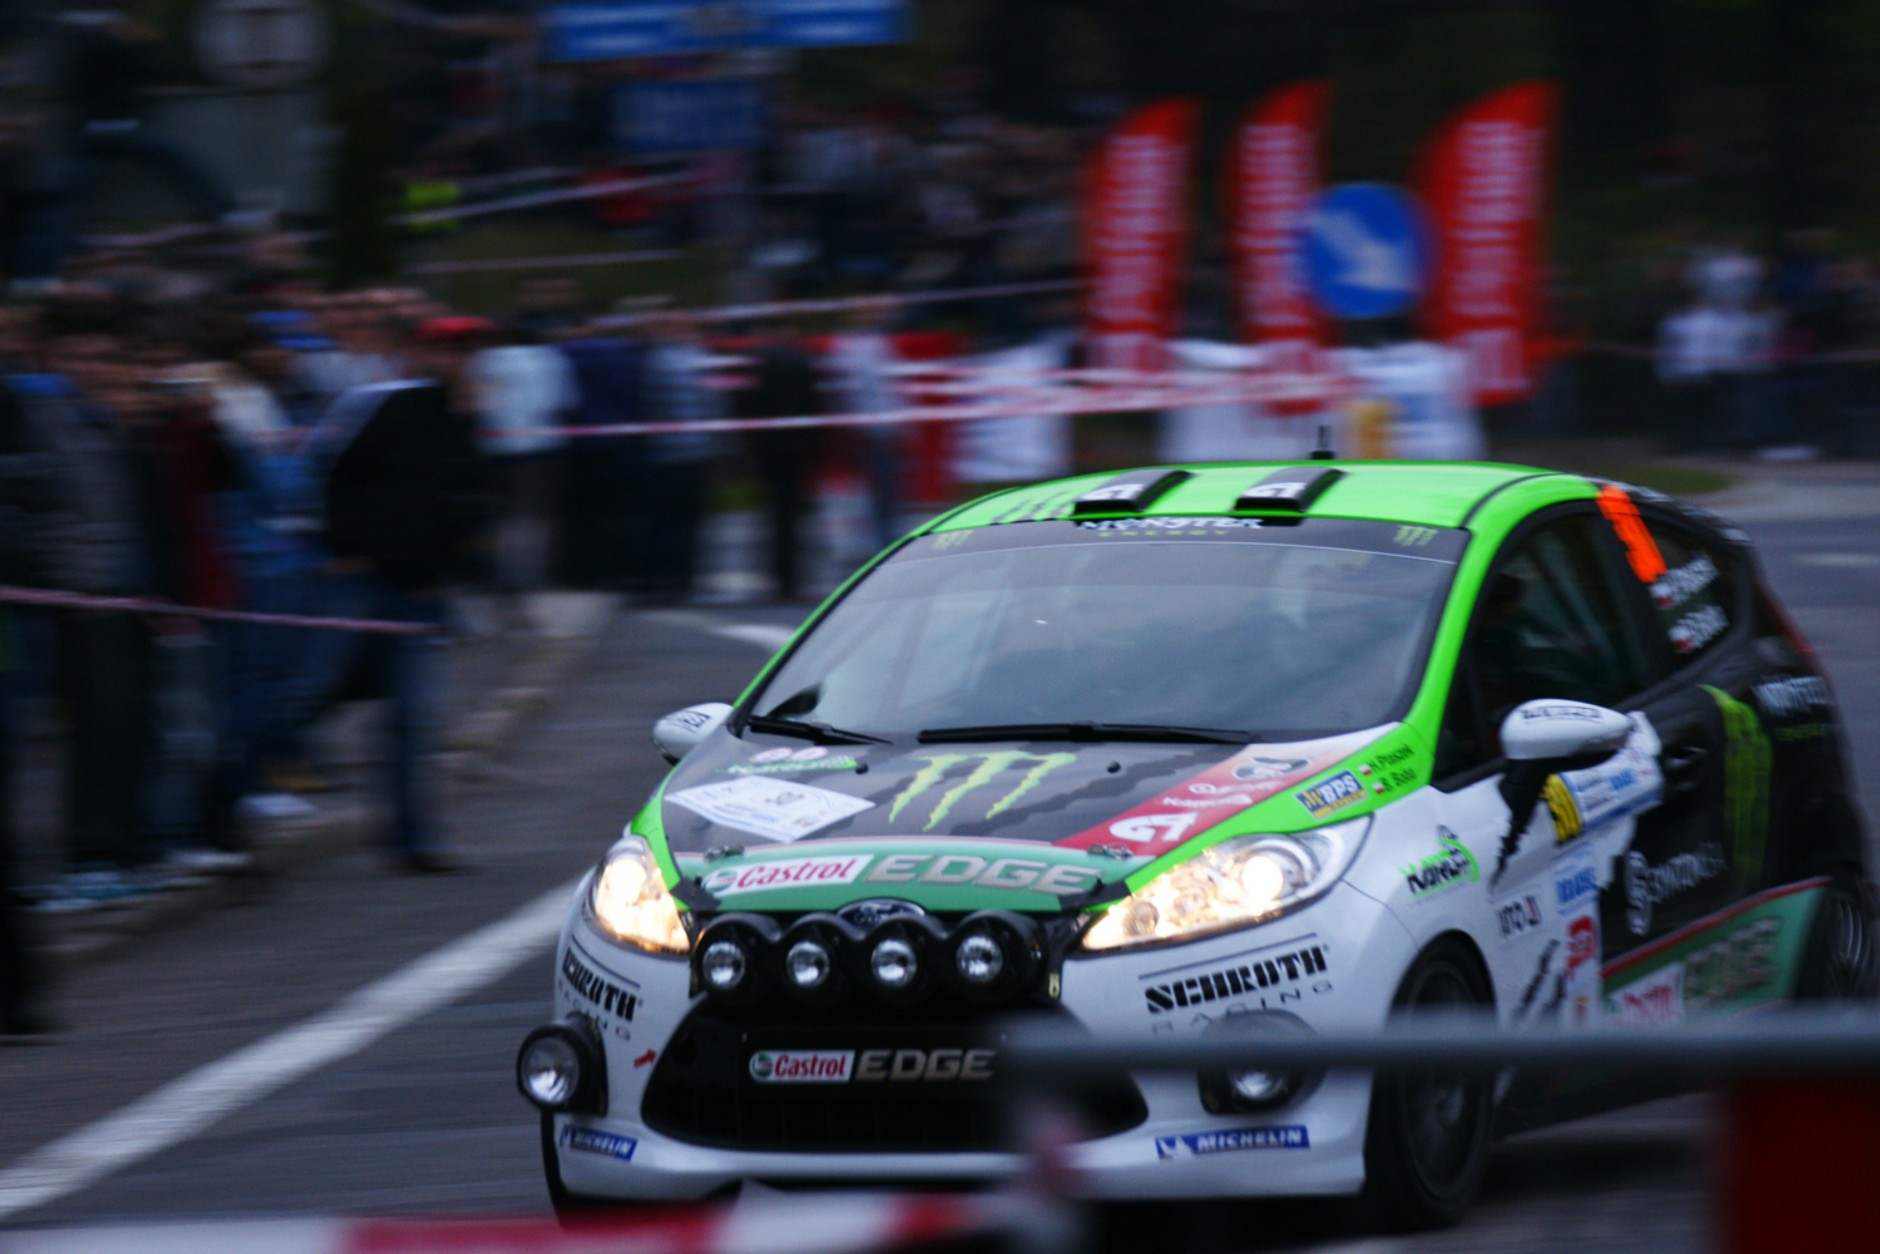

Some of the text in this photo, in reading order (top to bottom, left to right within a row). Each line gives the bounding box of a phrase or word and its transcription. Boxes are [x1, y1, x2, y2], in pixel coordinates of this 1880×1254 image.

[1078, 517, 1263, 530] MONSTER
[737, 854, 1103, 896] Castrol EDGE
[1145, 945, 1327, 1014] SCHROTH
[775, 1050, 997, 1081] Castrol EDGE
[1196, 1129, 1303, 1152] MICHELIN
